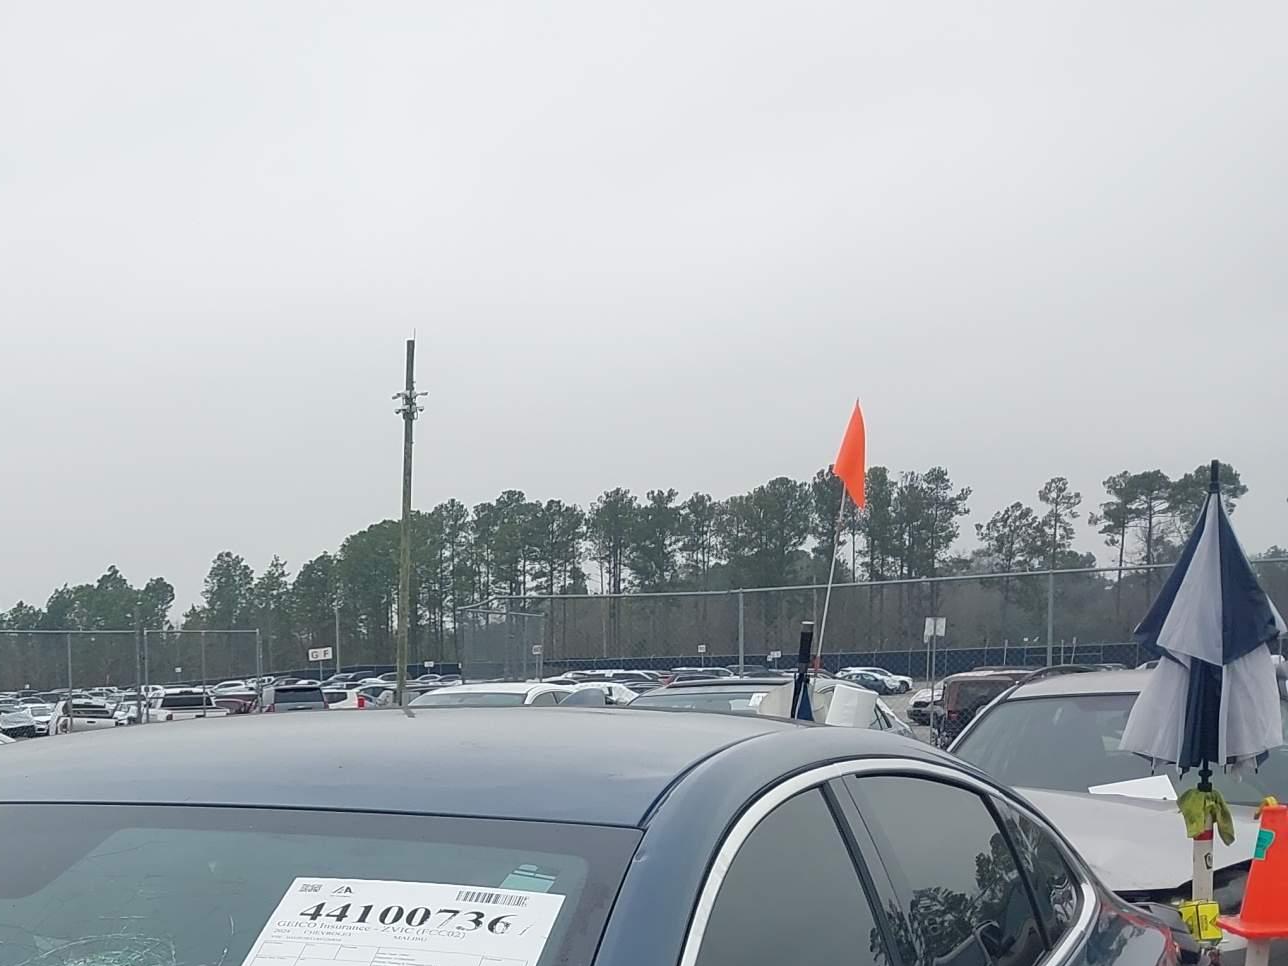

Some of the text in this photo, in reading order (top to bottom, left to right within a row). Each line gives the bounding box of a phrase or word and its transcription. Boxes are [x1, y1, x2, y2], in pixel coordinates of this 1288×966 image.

[277, 920, 318, 930] GEICO
[319, 922, 371, 933] Insurance
[299, 901, 518, 935] 44100736
